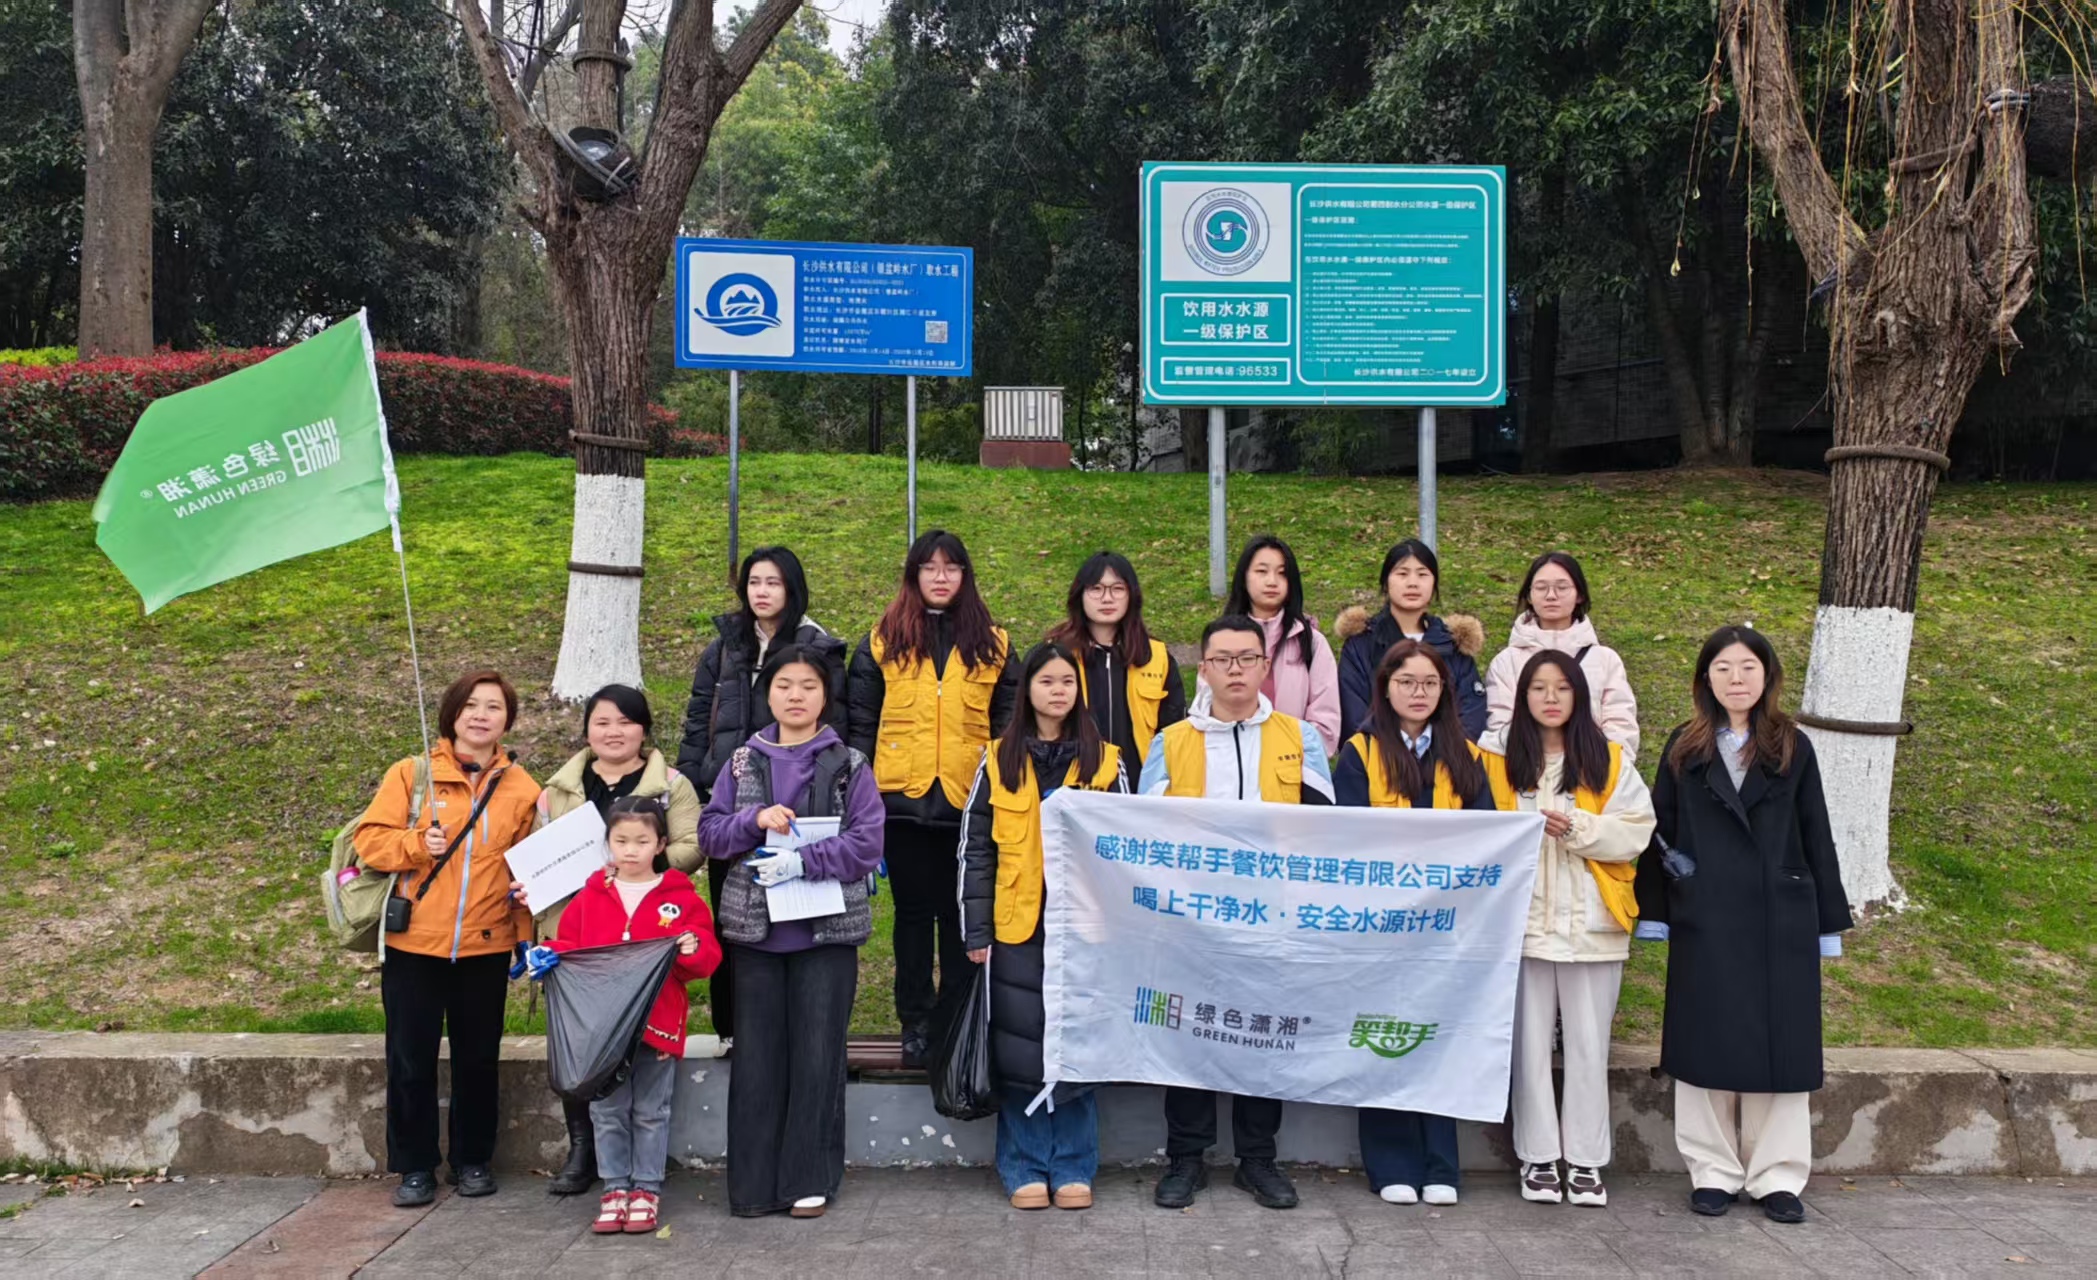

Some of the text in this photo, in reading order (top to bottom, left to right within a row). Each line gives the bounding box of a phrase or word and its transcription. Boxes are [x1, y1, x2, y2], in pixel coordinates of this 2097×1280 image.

[1183, 301, 1269, 317] 饮用水水源
[1183, 323, 1269, 339] 一级保护区
[1095, 835, 1503, 891] 感谢笑帮手餐饮管理有限公司支持
[1192, 1027, 1296, 1051] GREEN HUNAN
[1349, 1020, 1439, 1058] 笑帮手
